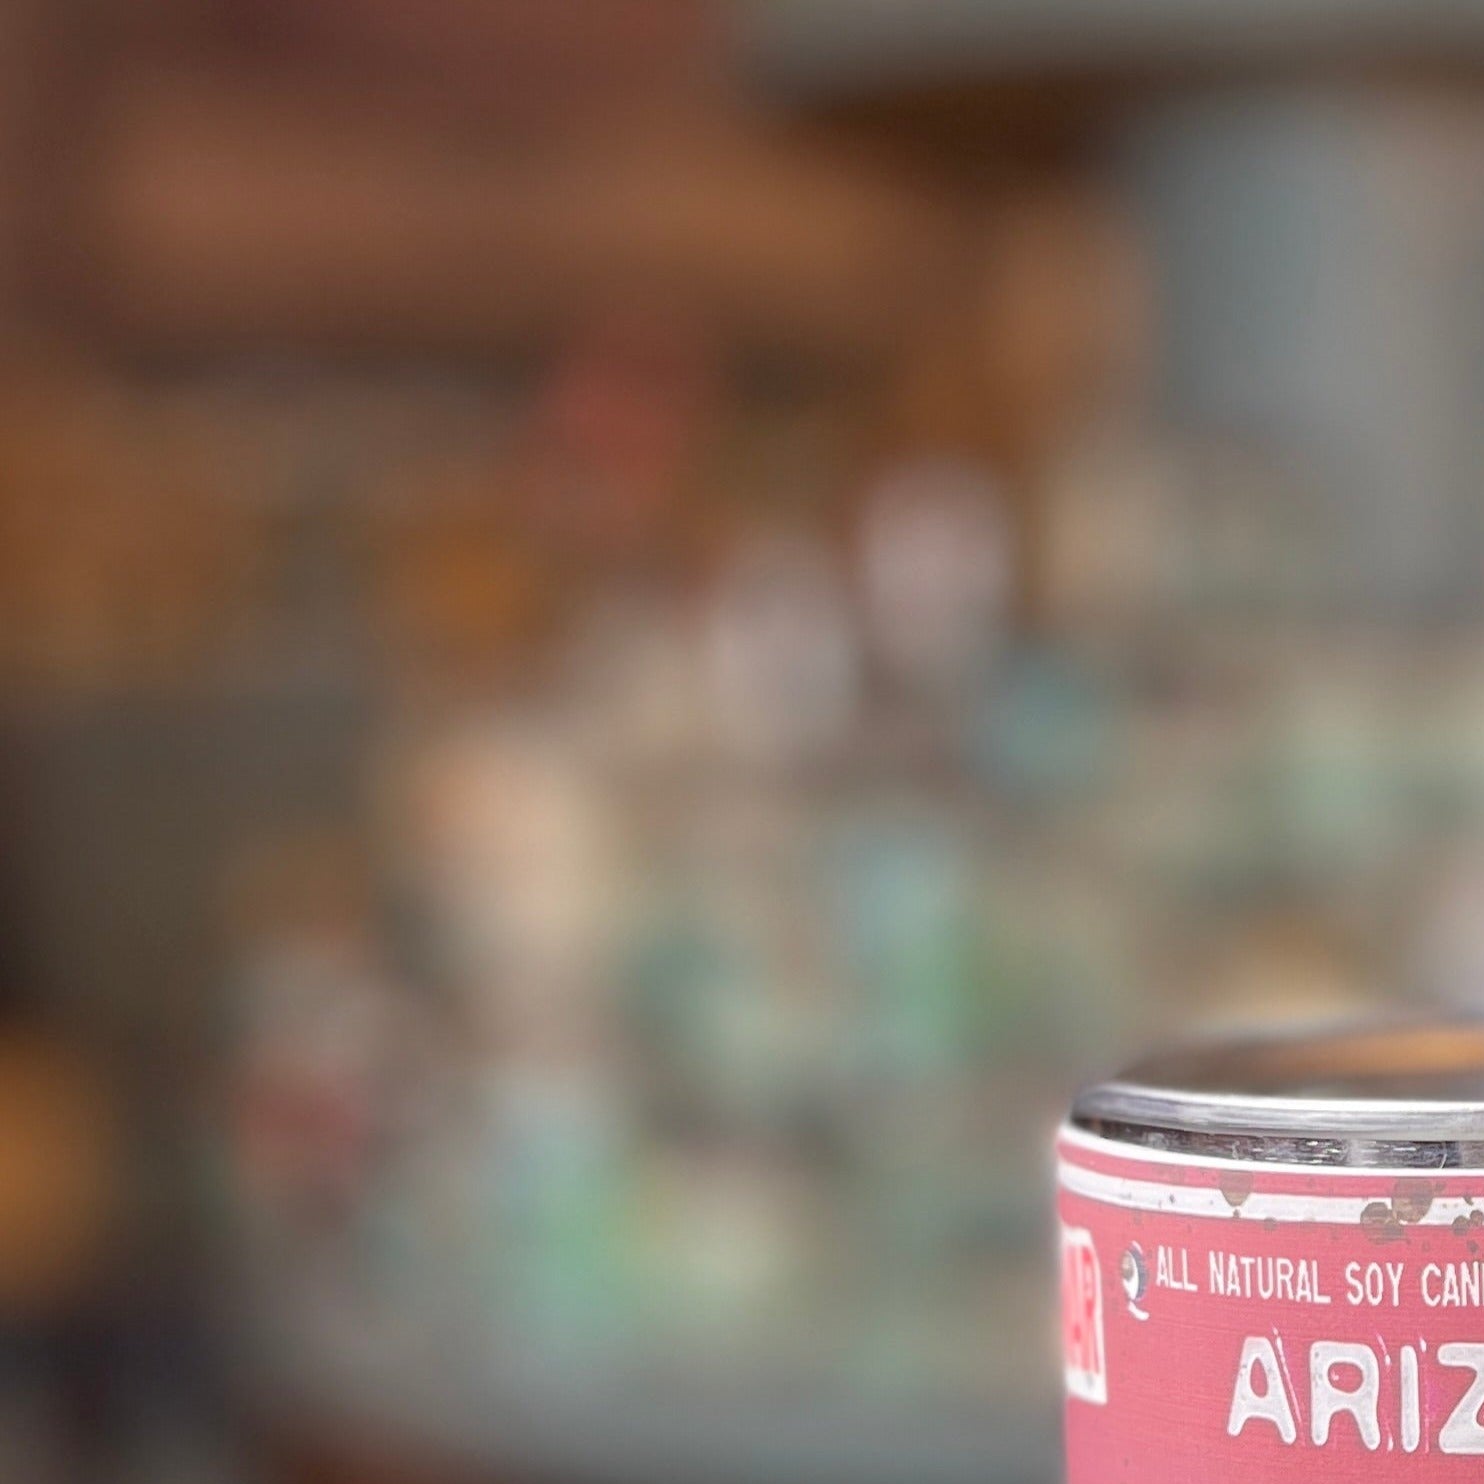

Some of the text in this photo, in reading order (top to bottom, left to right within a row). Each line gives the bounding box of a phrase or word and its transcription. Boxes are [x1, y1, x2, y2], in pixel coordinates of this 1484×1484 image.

[1155, 1243, 1198, 1292] ALL
[1209, 1251, 1331, 1302] NATURAL
[1345, 1262, 1404, 1307] SOY
